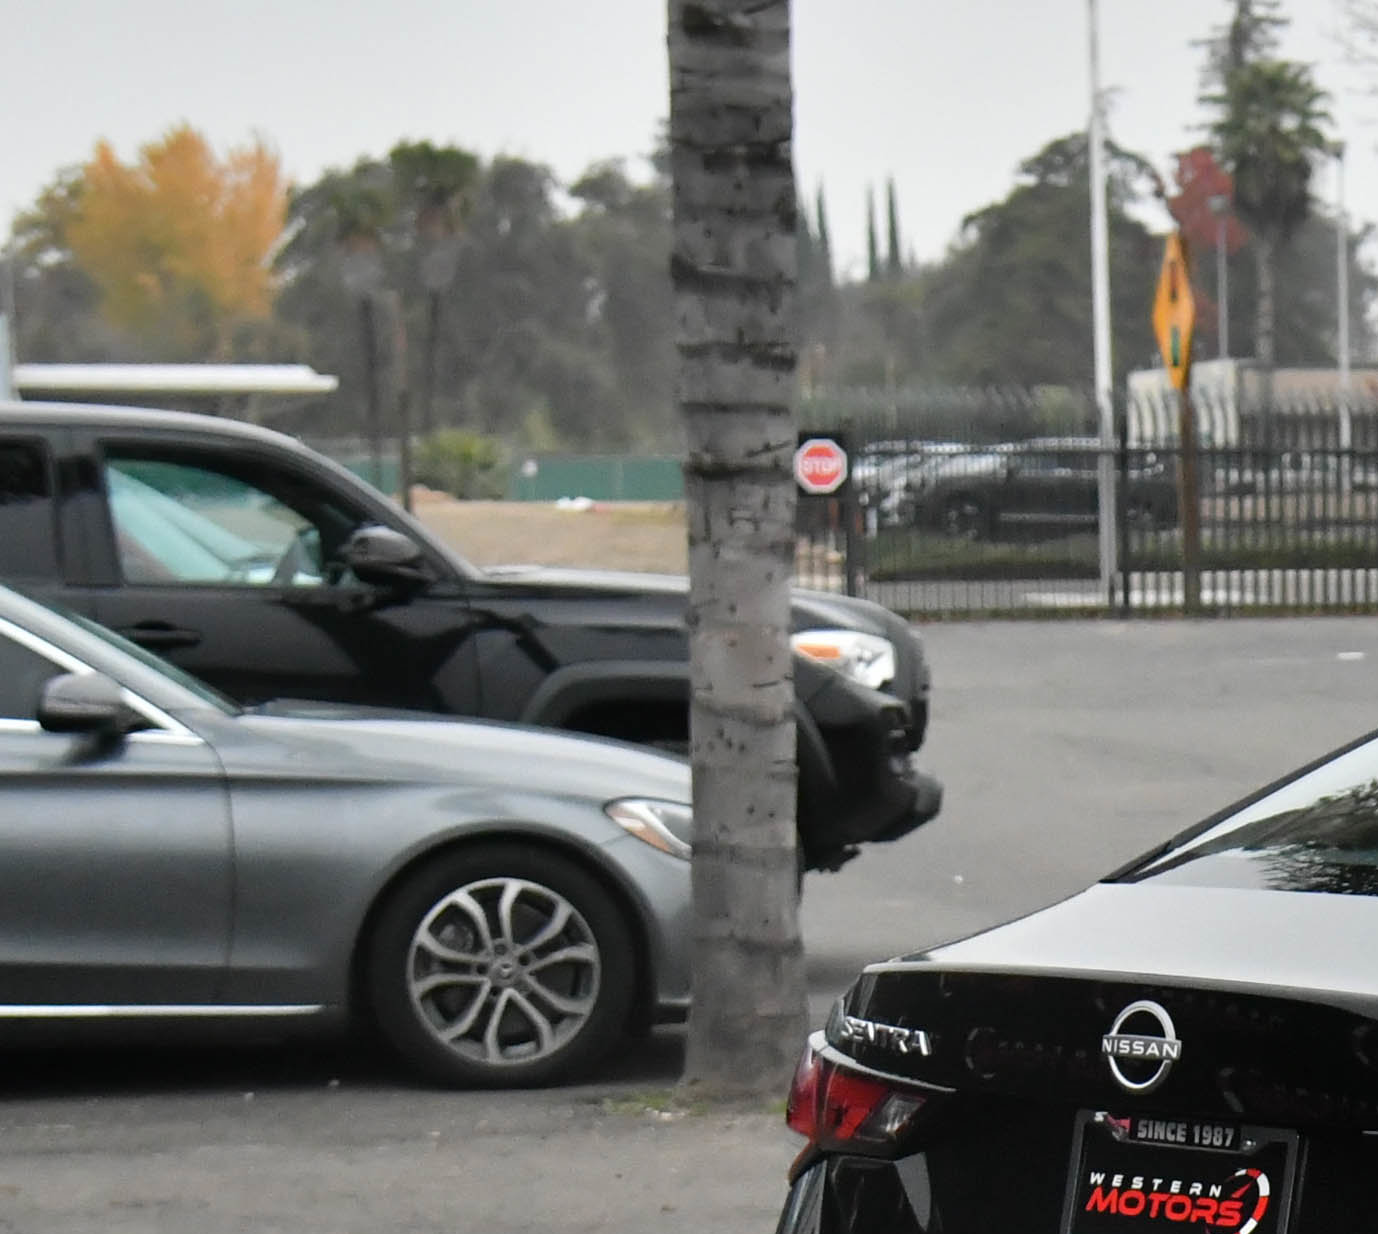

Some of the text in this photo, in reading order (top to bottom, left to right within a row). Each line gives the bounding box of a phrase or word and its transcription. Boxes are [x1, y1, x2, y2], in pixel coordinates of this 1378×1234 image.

[801, 456, 840, 475] STOP
[841, 1016, 931, 1056] SENTRA
[1101, 1037, 1178, 1058] NISSAN
[1136, 1119, 1235, 1147] SINCE 1987
[1089, 1171, 1223, 1198] WESTERN
[1085, 1186, 1244, 1227] MOTORS
